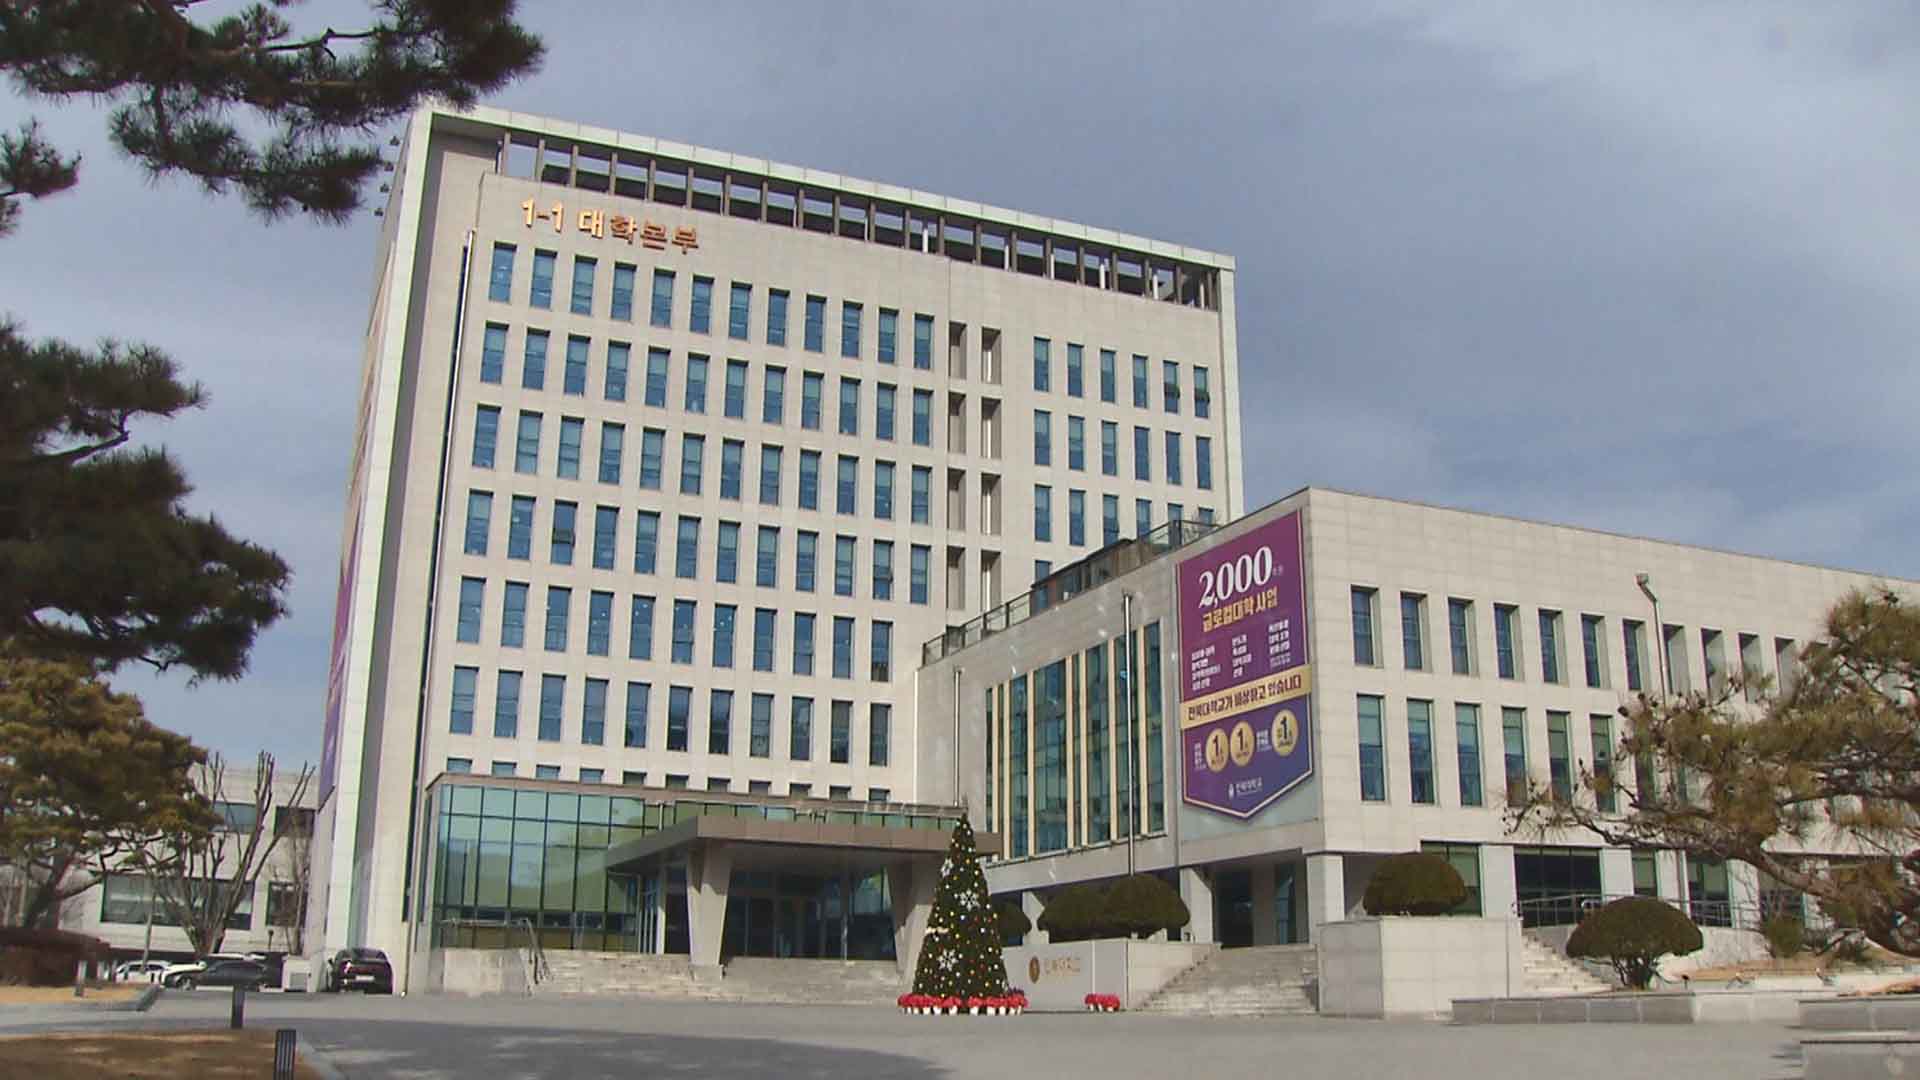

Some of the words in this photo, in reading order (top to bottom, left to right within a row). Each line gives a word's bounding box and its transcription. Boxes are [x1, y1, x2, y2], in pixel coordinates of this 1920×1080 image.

[521, 197, 564, 233] 1-1
[578, 209, 699, 255] 대학본부
[1199, 546, 1272, 608] 2,000
[1256, 586, 1278, 612] 사업
